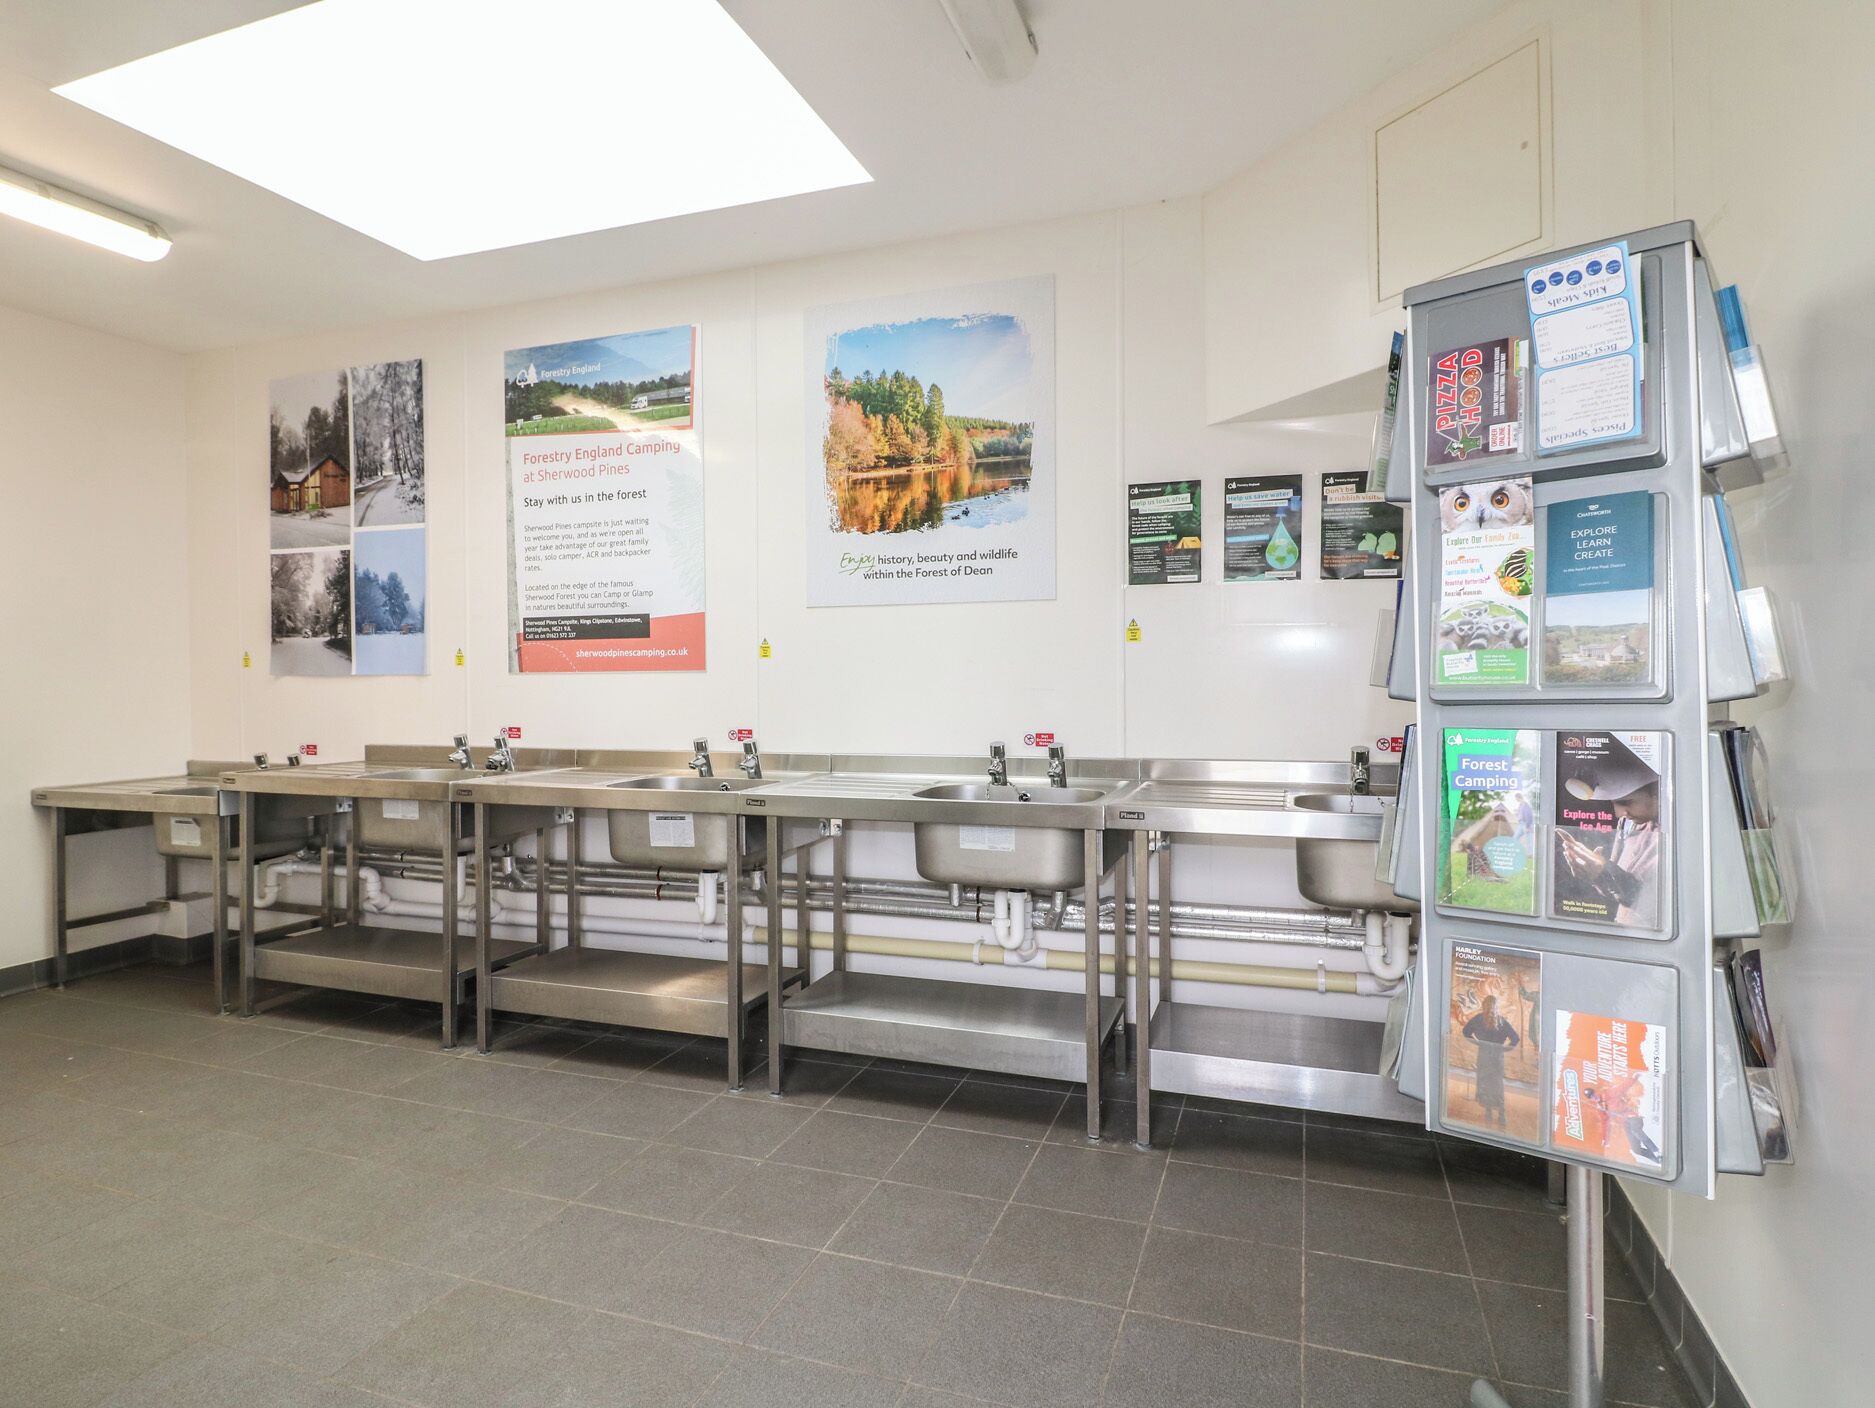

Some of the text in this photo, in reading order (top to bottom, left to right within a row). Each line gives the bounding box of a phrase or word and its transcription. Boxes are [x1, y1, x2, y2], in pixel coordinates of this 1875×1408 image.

[1547, 285, 1607, 307] Kids Meals
[1553, 343, 1618, 363] Best Sellers
[540, 362, 600, 379] Forestry England
[1436, 352, 1458, 431] PIZZA
[1460, 348, 1483, 426] HOOD
[1545, 422, 1626, 443] Pisces Specials
[523, 439, 680, 466] Forestry England Camping
[523, 463, 629, 482] at Sherwood Pines
[524, 488, 646, 508] Stay with us in the forest
[1132, 499, 1147, 507] Help
[1228, 494, 1244, 502] Help
[524, 523, 553, 532] Sherwood
[573, 521, 601, 529] campsite
[610, 519, 622, 527] just
[625, 518, 648, 526] waiting
[1571, 526, 1617, 538] EXPLORE
[554, 542, 586, 550] advantage
[609, 540, 626, 548] great
[628, 538, 648, 546] family
[1446, 537, 1469, 547] Explore
[1472, 536, 1482, 544] Our
[1577, 538, 1611, 549] LEARN
[614, 548, 650, 556] backpacker
[1574, 549, 1613, 560] CREATE
[840, 548, 1018, 575] Enjoy history, beauty and wildlife
[863, 566, 993, 580] within the Forest of Dean
[572, 582, 587, 590] edge
[603, 590, 621, 598] Camp
[631, 589, 653, 597] Glamp
[587, 601, 629, 609] surroundings.
[576, 648, 687, 657] sherwoodpinescamping.co.uk
[1461, 758, 1508, 771] Forest
[1455, 775, 1518, 790] Camping
[1564, 809, 1613, 820] Explore the
[1580, 822, 1613, 833] Ice Age
[1456, 946, 1482, 955] HARLEY
[1456, 952, 1496, 963] FOUNDATION
[1612, 1021, 1628, 1077] STARTS HERE
[1597, 1031, 1612, 1082] ADVENTURE
[1583, 1061, 1598, 1084] YOUR
[1564, 1069, 1583, 1140] Adventures
